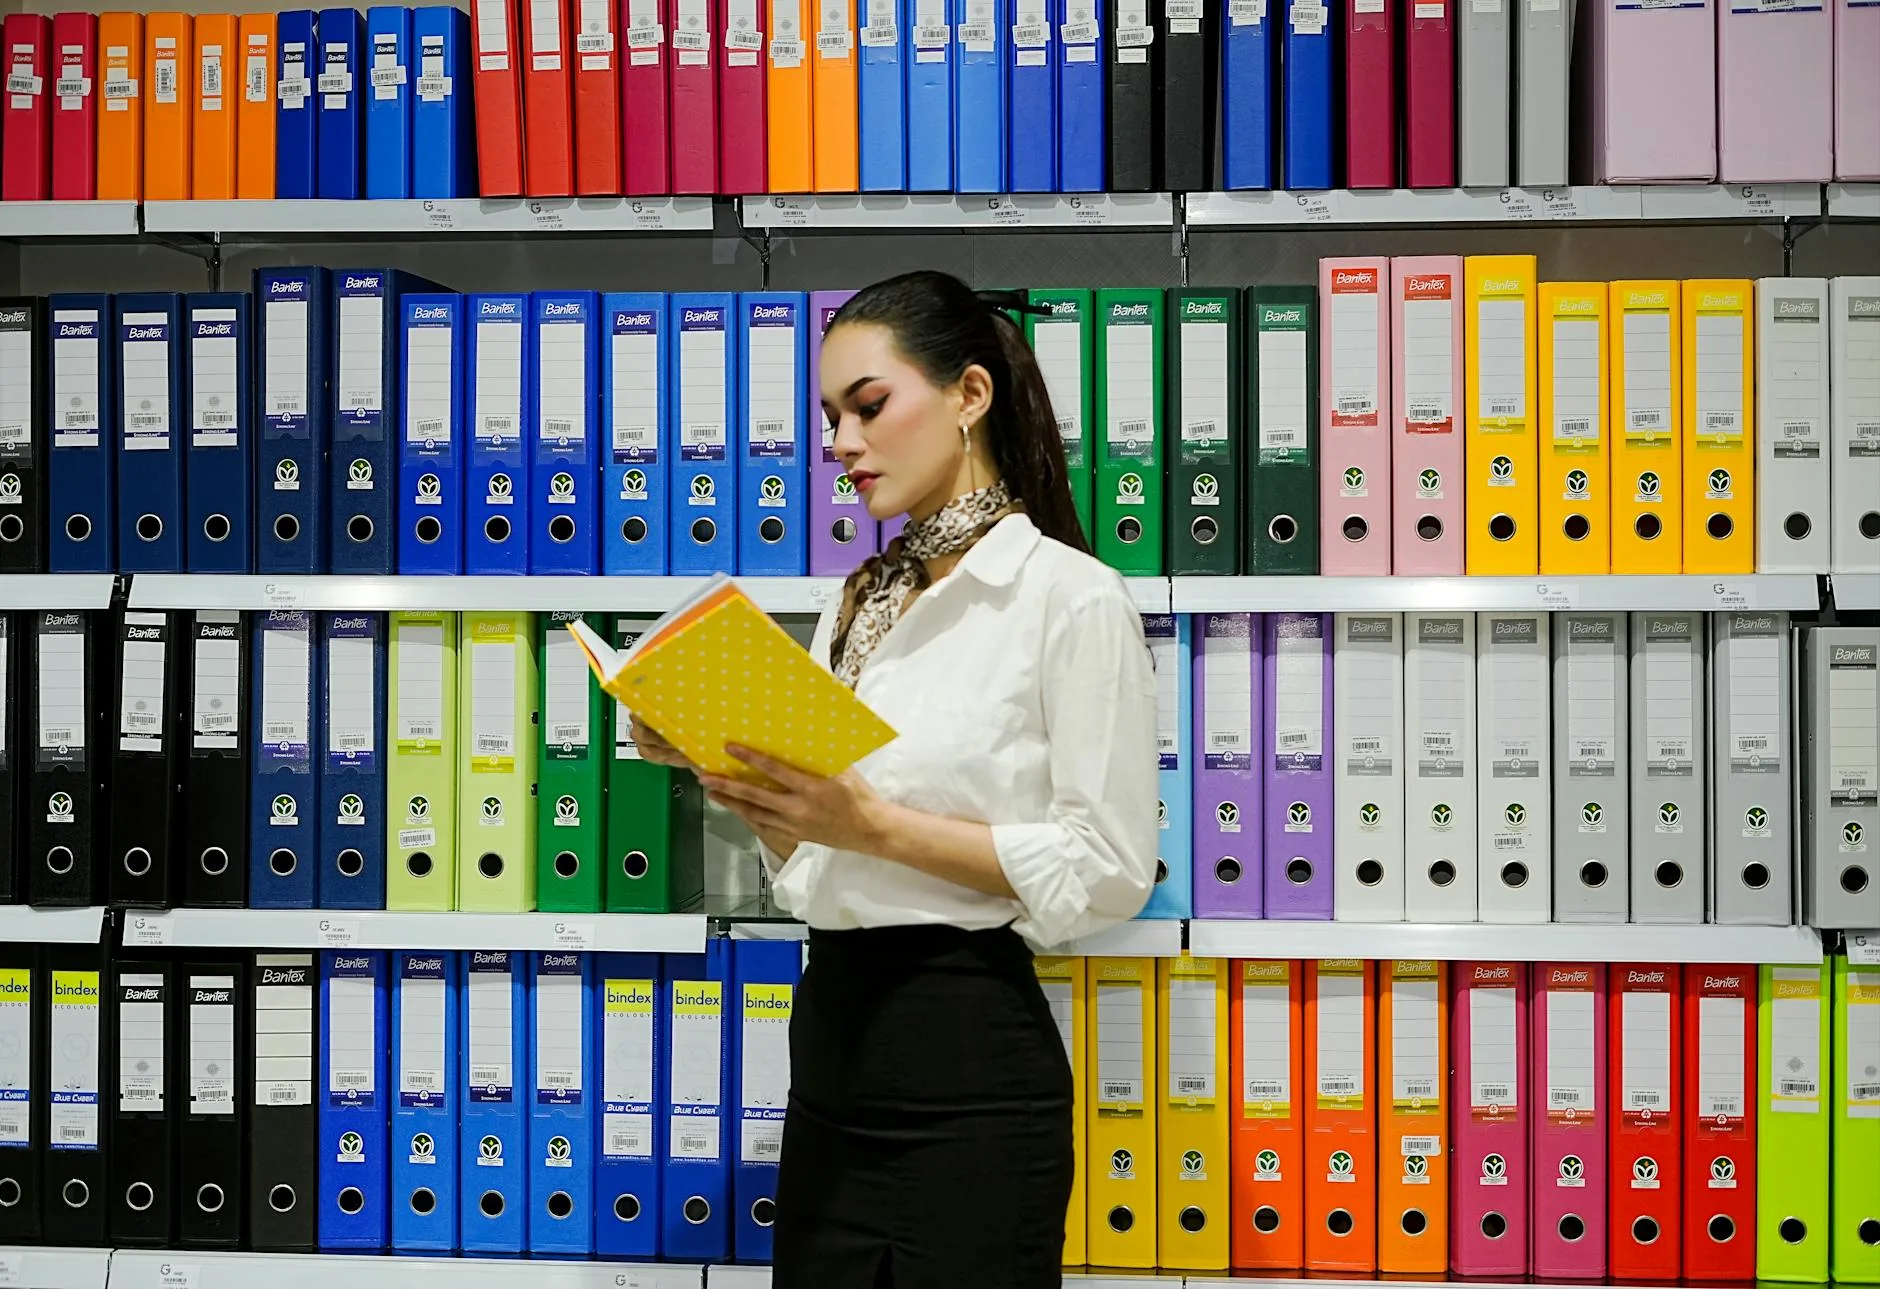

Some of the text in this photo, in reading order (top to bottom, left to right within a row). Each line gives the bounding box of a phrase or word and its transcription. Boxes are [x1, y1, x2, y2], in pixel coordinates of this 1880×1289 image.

[346, 277, 379, 288] Bantex
[1336, 272, 1372, 284] Bantex
[272, 281, 304, 293] Bantex
[1409, 279, 1445, 291] Bantex
[1484, 280, 1518, 292] Bantex
[1629, 293, 1665, 304] Bantex
[414, 307, 448, 319] Bantex
[482, 302, 516, 314] Bantex
[546, 304, 580, 315] Bantex
[754, 306, 789, 318] Bantex
[1113, 304, 1148, 316] Bantex
[1186, 302, 1222, 314] Bantex
[1780, 302, 1814, 314] Bantex
[617, 314, 652, 326] Bantex
[684, 310, 719, 322] Bantex
[1265, 310, 1300, 322] Bantex
[60, 324, 94, 336] Bantex
[129, 328, 162, 338] Bantex
[198, 324, 232, 334] Bantex
[46, 614, 80, 625] Bantex
[269, 610, 304, 621] Bantex
[552, 610, 584, 621] Bantex
[334, 618, 368, 629] Bantex
[1352, 620, 1387, 633] Bantex
[1424, 622, 1460, 634] Bantex
[1496, 622, 1531, 634] Bantex
[1573, 622, 1609, 634] Bantex
[1652, 622, 1688, 634] Bantex
[1736, 618, 1772, 630] Bantex
[128, 627, 160, 639] Bantex
[201, 626, 235, 637] Bantex
[1836, 648, 1870, 660] Bantex
[334, 957, 369, 969] Bantex
[408, 958, 442, 970] Bantex
[474, 952, 507, 964] Bantex
[544, 954, 578, 966] Bantex
[1248, 965, 1284, 976] Bantex
[1398, 961, 1432, 973] Bantex
[1474, 967, 1510, 979] Bantex
[262, 968, 305, 984] Bantex
[1552, 970, 1588, 983] Bantex
[1628, 970, 1664, 984] Bantex
[55, 980, 98, 996] bindex
[1704, 976, 1740, 989] Bantex
[126, 988, 159, 1000] Bantex
[196, 990, 230, 1002] Bantex
[608, 988, 651, 1004] bindex
[676, 990, 720, 1006] bindex
[746, 993, 790, 1009] bindex
